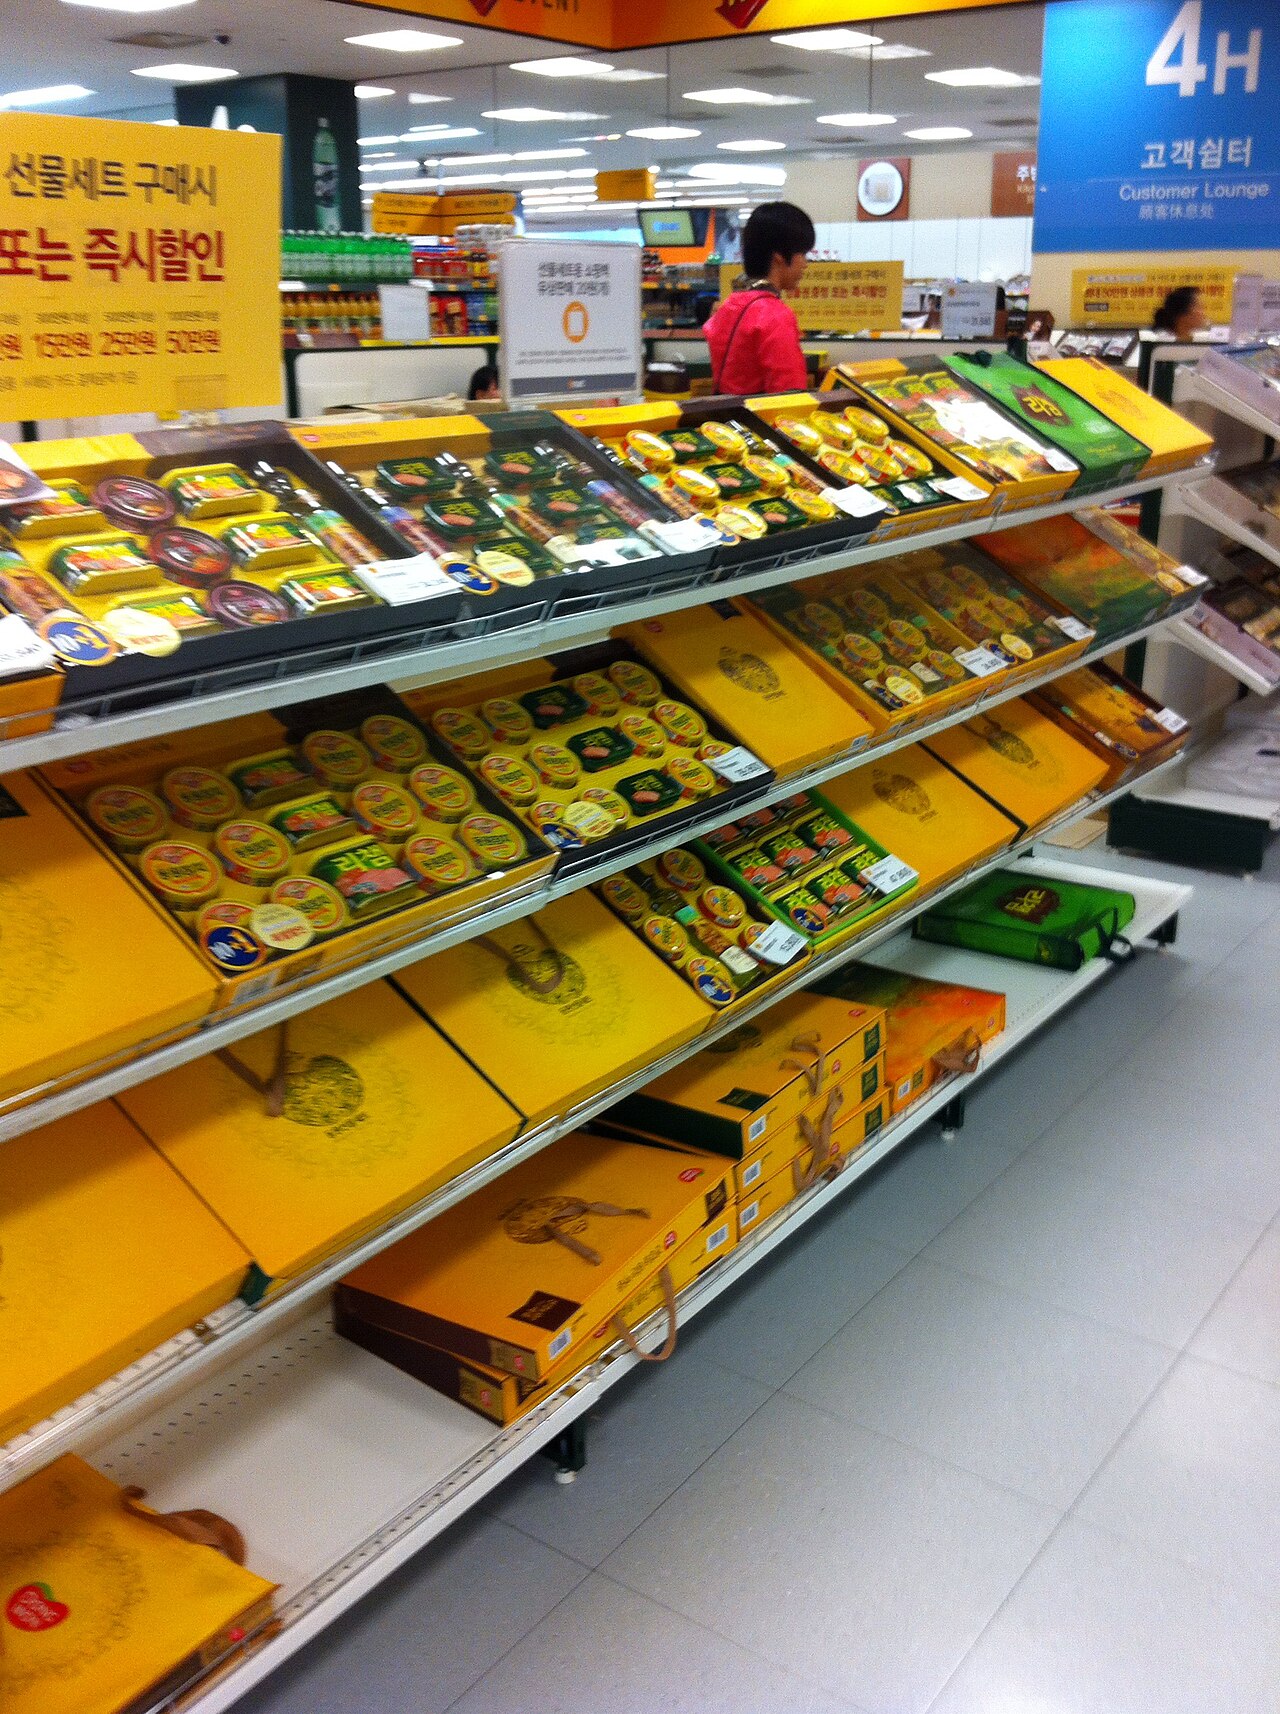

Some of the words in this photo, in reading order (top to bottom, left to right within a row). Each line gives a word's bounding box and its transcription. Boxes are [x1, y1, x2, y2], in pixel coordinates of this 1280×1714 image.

[1140, 138, 1253, 170] 고객쉼터
[1119, 184, 1199, 201] Customer
[1204, 181, 1271, 201] Lounge
[0, 228, 74, 282] 또는
[83, 228, 225, 282] 즉시할인
[329, 844, 395, 872] 리챔
